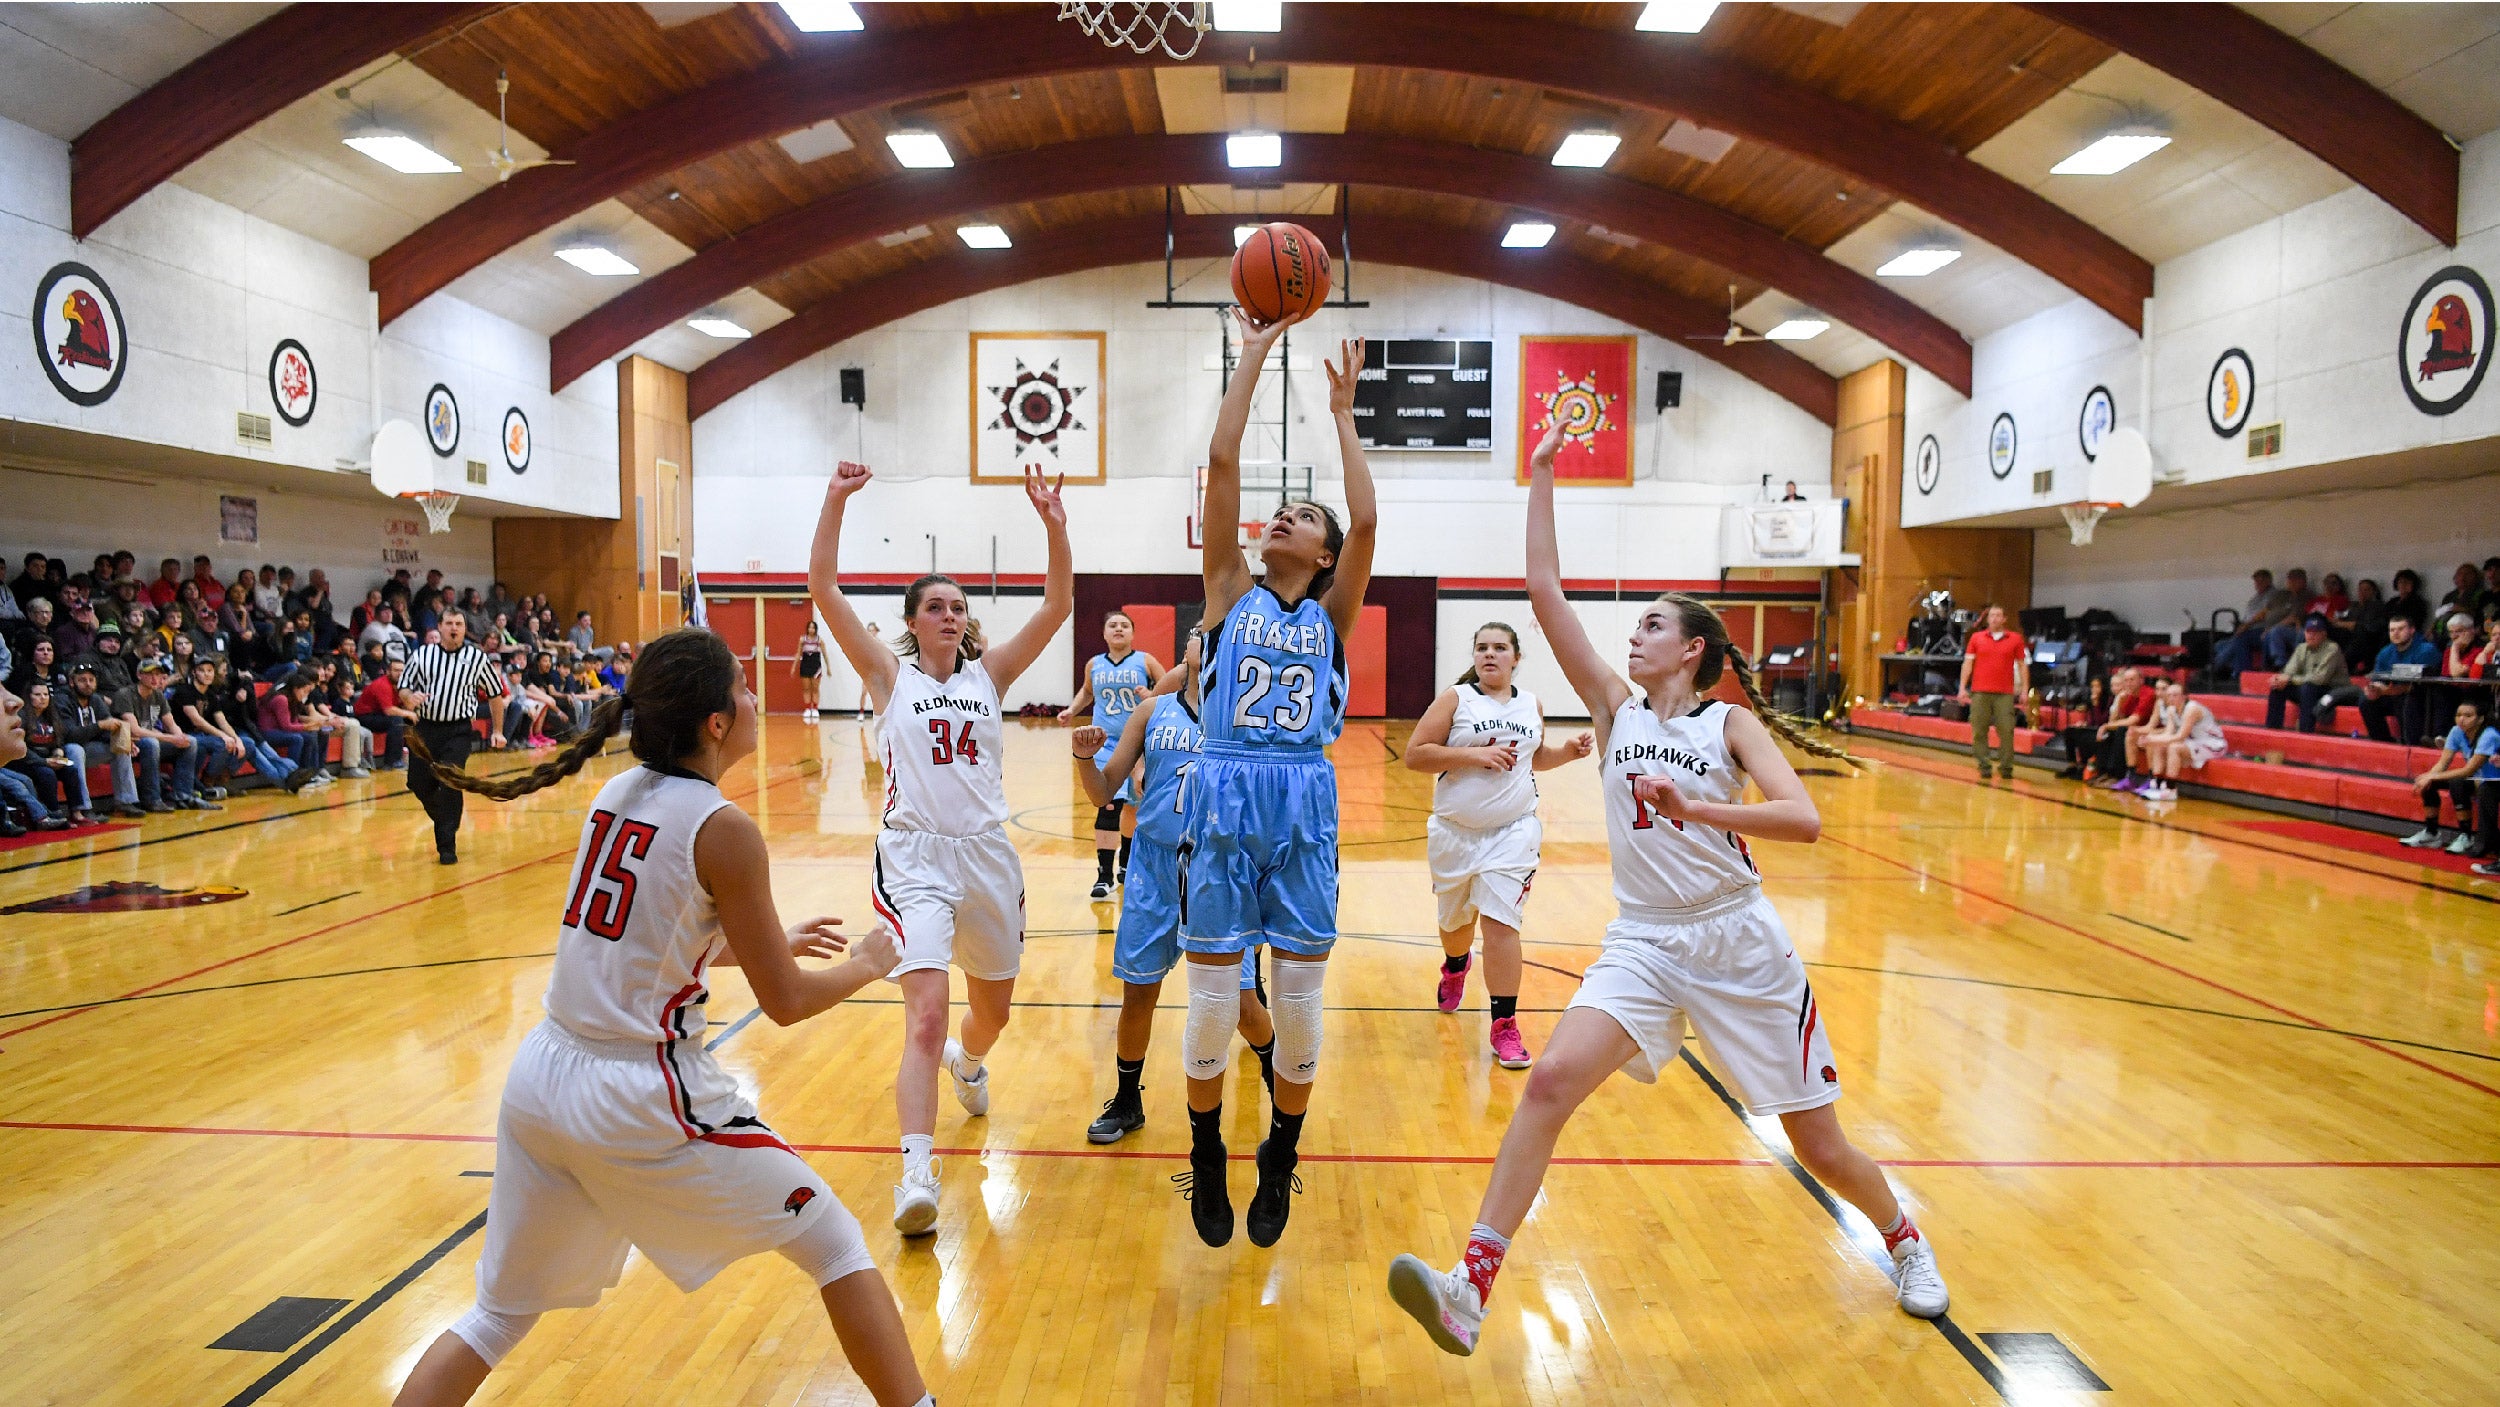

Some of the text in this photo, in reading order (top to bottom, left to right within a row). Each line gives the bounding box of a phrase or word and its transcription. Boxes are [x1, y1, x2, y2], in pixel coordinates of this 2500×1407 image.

[1282, 233, 1304, 299] Baden
[1452, 369, 1488, 382] GUEST
[1396, 407, 1446, 418] PLAYER FOUL
[1232, 611, 1327, 657] FRAZER
[1094, 669, 1139, 686] FRAZER
[912, 694, 990, 717] REDHAWKS
[1102, 687, 1137, 716] 20
[1232, 655, 1314, 732] 23
[928, 718, 978, 765] 34
[1473, 719, 1534, 739] REDHAWKS
[1615, 743, 1710, 777] REDHAWKS
[562, 808, 660, 942] 15
